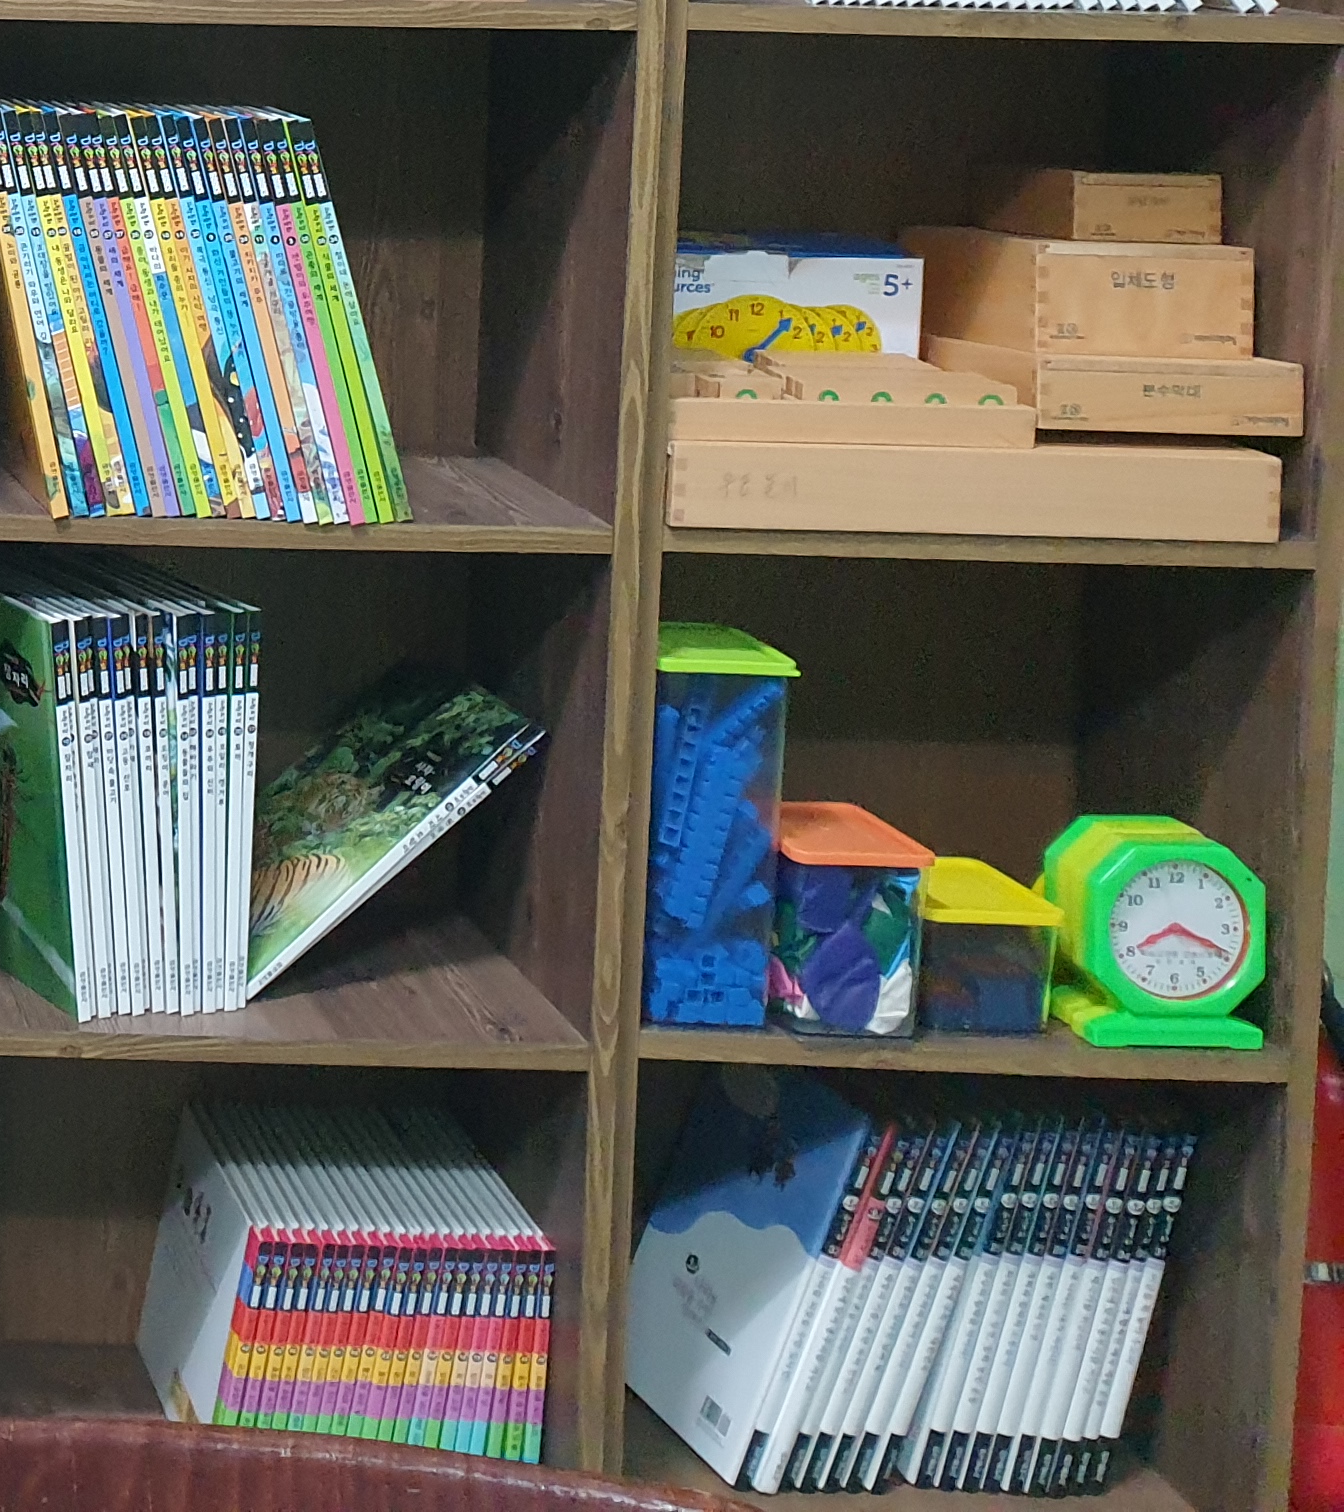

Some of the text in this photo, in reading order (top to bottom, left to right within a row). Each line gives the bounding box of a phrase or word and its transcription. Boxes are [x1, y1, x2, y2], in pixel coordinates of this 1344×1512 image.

[883, 273, 913, 297] 5+
[1110, 270, 1176, 291] 입체도형
[728, 307, 740, 322] 11
[749, 302, 803, 340] 12 2
[709, 324, 726, 339] 10
[1142, 383, 1202, 398] 분수막대
[1148, 877, 1161, 889] 11
[1169, 871, 1185, 884] 12
[1198, 878, 1205, 890] 1
[1126, 894, 1144, 906] 10
[1214, 897, 1224, 909] 2
[1118, 920, 1128, 932] 9
[1220, 923, 1230, 935] 3
[1125, 945, 1136, 957] 8
[1146, 964, 1155, 976] 7
[1196, 966, 1205, 978] 5
[1170, 973, 1179, 984] 6
